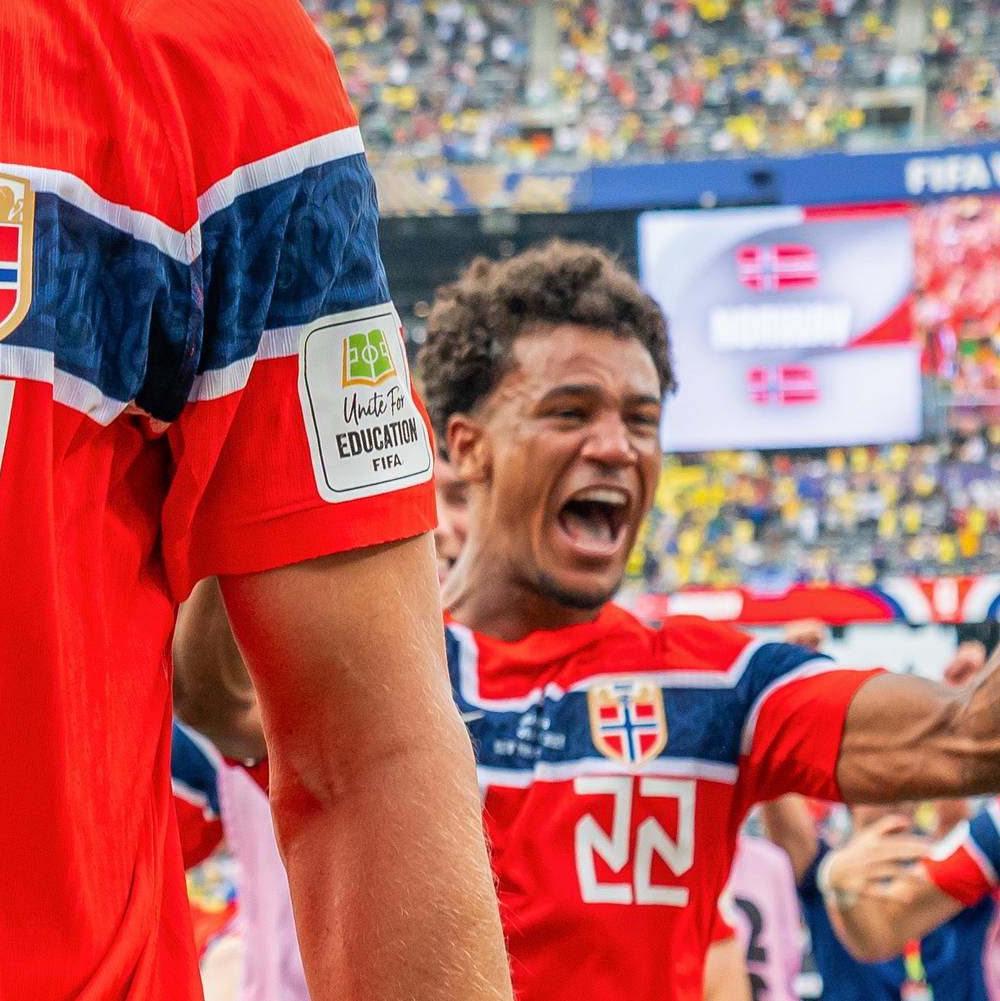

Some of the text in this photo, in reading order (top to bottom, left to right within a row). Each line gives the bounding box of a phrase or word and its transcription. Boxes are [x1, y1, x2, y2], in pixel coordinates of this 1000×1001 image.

[904, 152, 991, 195] FIFA
[343, 385, 405, 426] Unite For
[335, 417, 419, 459] EDUCATION
[372, 453, 403, 472] FIFA
[573, 775, 697, 908] 22
